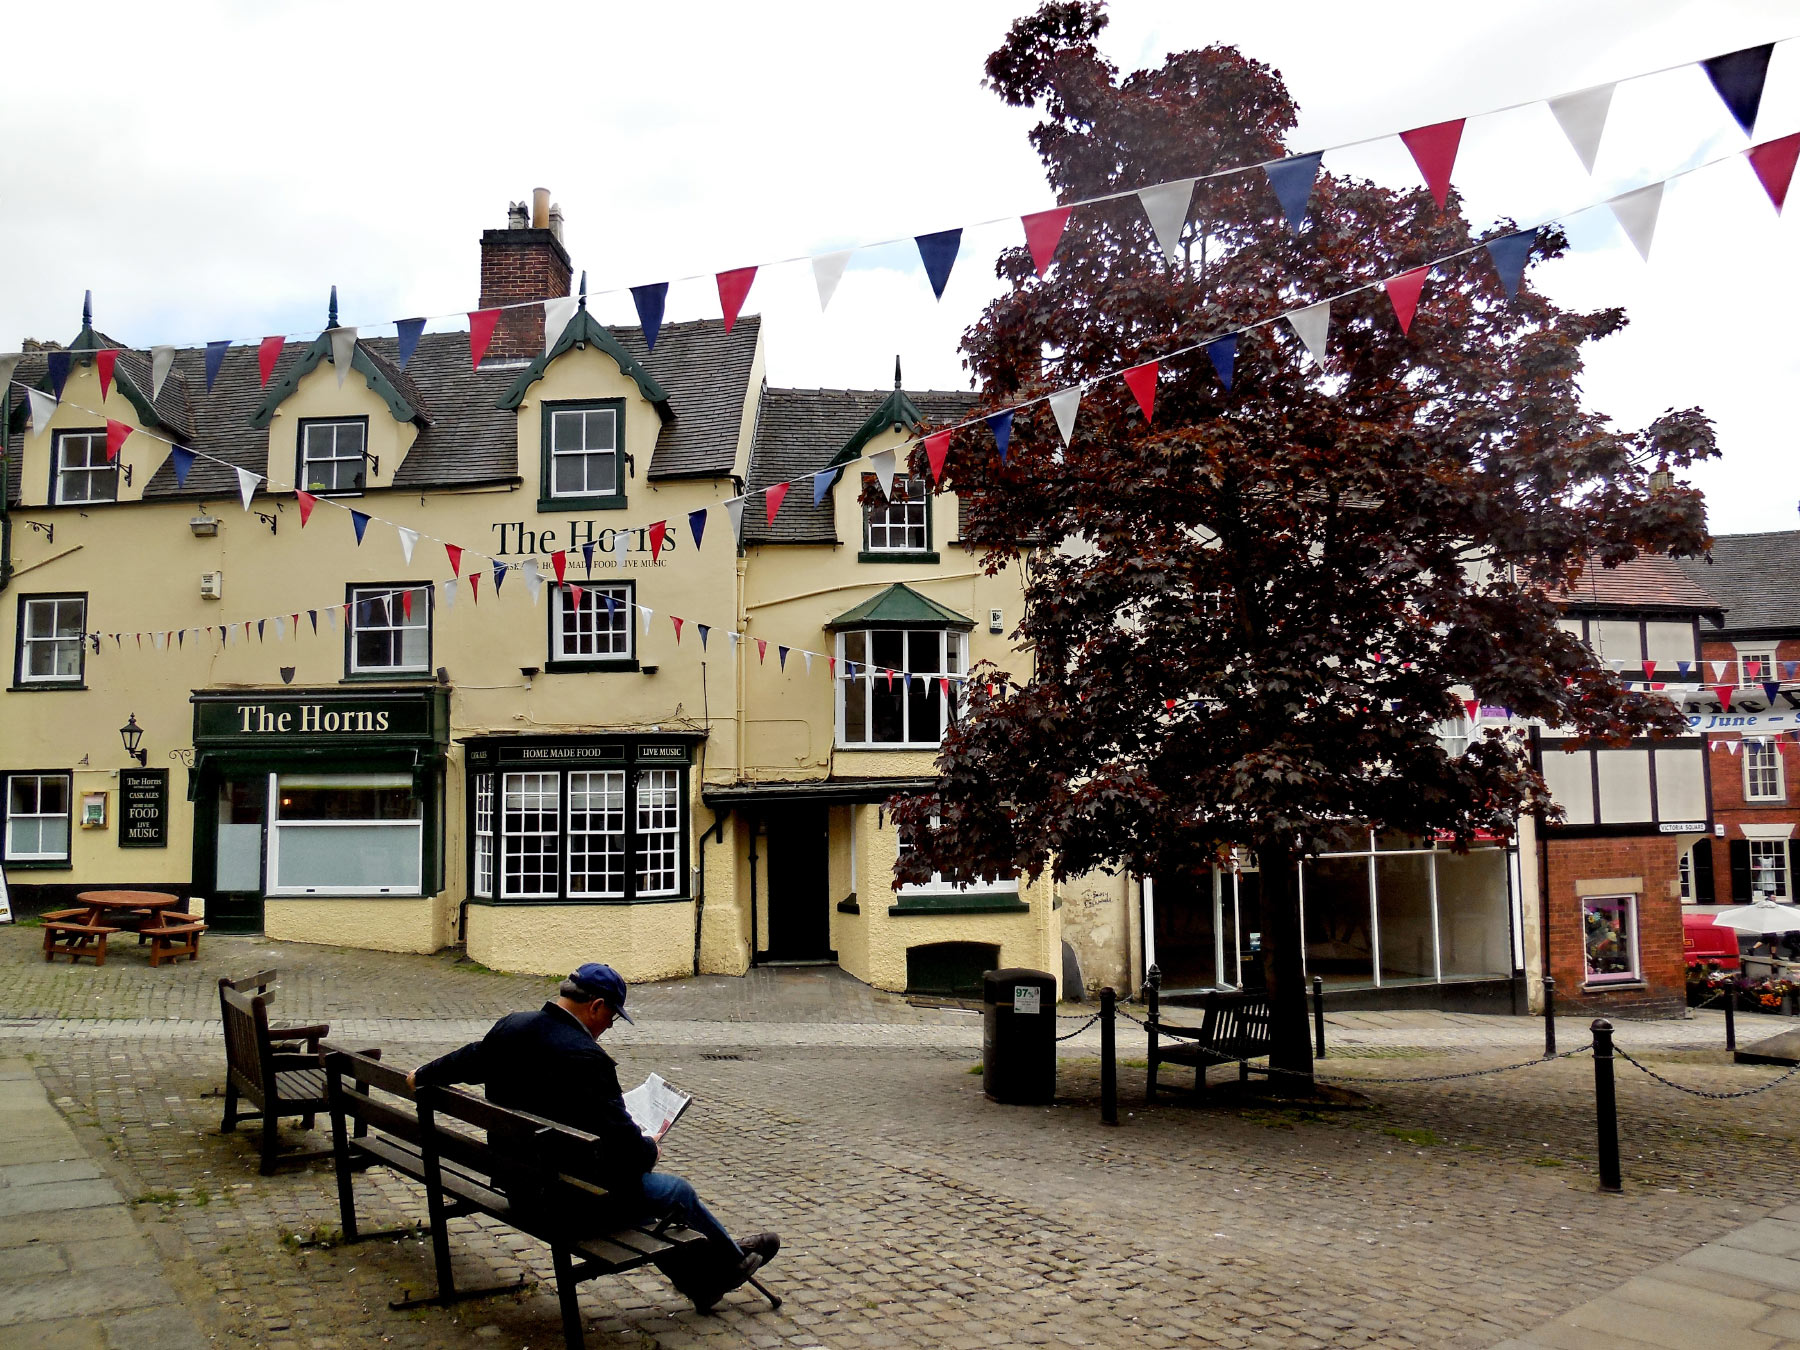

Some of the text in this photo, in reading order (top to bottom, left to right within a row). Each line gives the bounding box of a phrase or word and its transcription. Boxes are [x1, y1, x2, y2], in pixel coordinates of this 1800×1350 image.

[492, 522, 556, 555] The
[594, 560, 617, 569] FOOD
[641, 560, 667, 568] MUSIC
[237, 705, 389, 732] The Horns
[1705, 715, 1758, 729] June
[523, 748, 601, 758] HOME MADE FOOD
[643, 748, 682, 756] LIVE MUSIC
[127, 777, 162, 786] The Horns
[129, 808, 159, 818] FOOD
[1661, 823, 1705, 832] VICTORIA SQUARE
[128, 828, 159, 838] MUSIC
